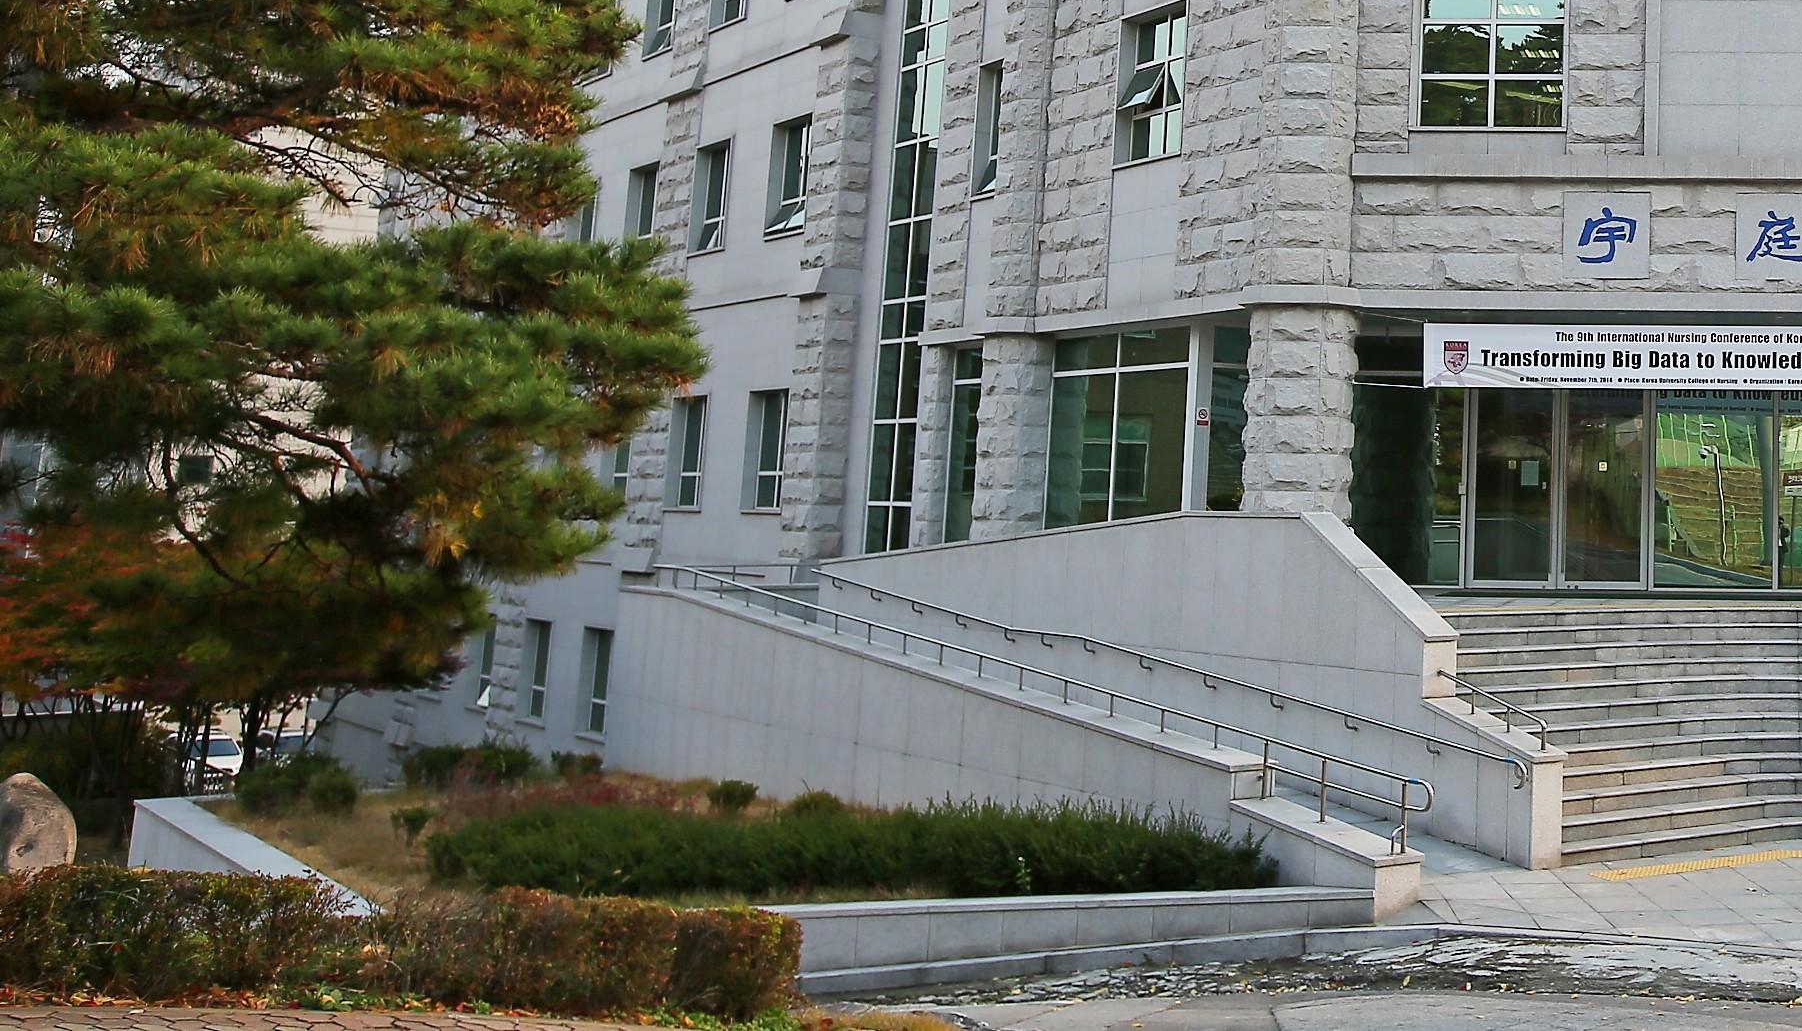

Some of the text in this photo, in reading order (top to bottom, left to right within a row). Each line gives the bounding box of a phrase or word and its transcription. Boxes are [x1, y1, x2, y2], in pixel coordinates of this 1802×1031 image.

[1555, 331, 1574, 342] The
[1577, 332, 1594, 342] 9th
[1597, 332, 1665, 342] International
[1667, 332, 1707, 344] Nursing
[1710, 333, 1770, 343] Conference
[1773, 333, 1784, 343] of
[1480, 349, 1606, 370] Transforming
[1612, 350, 1642, 370] Big
[1648, 350, 1690, 369] Data
[1697, 352, 1715, 369] to
